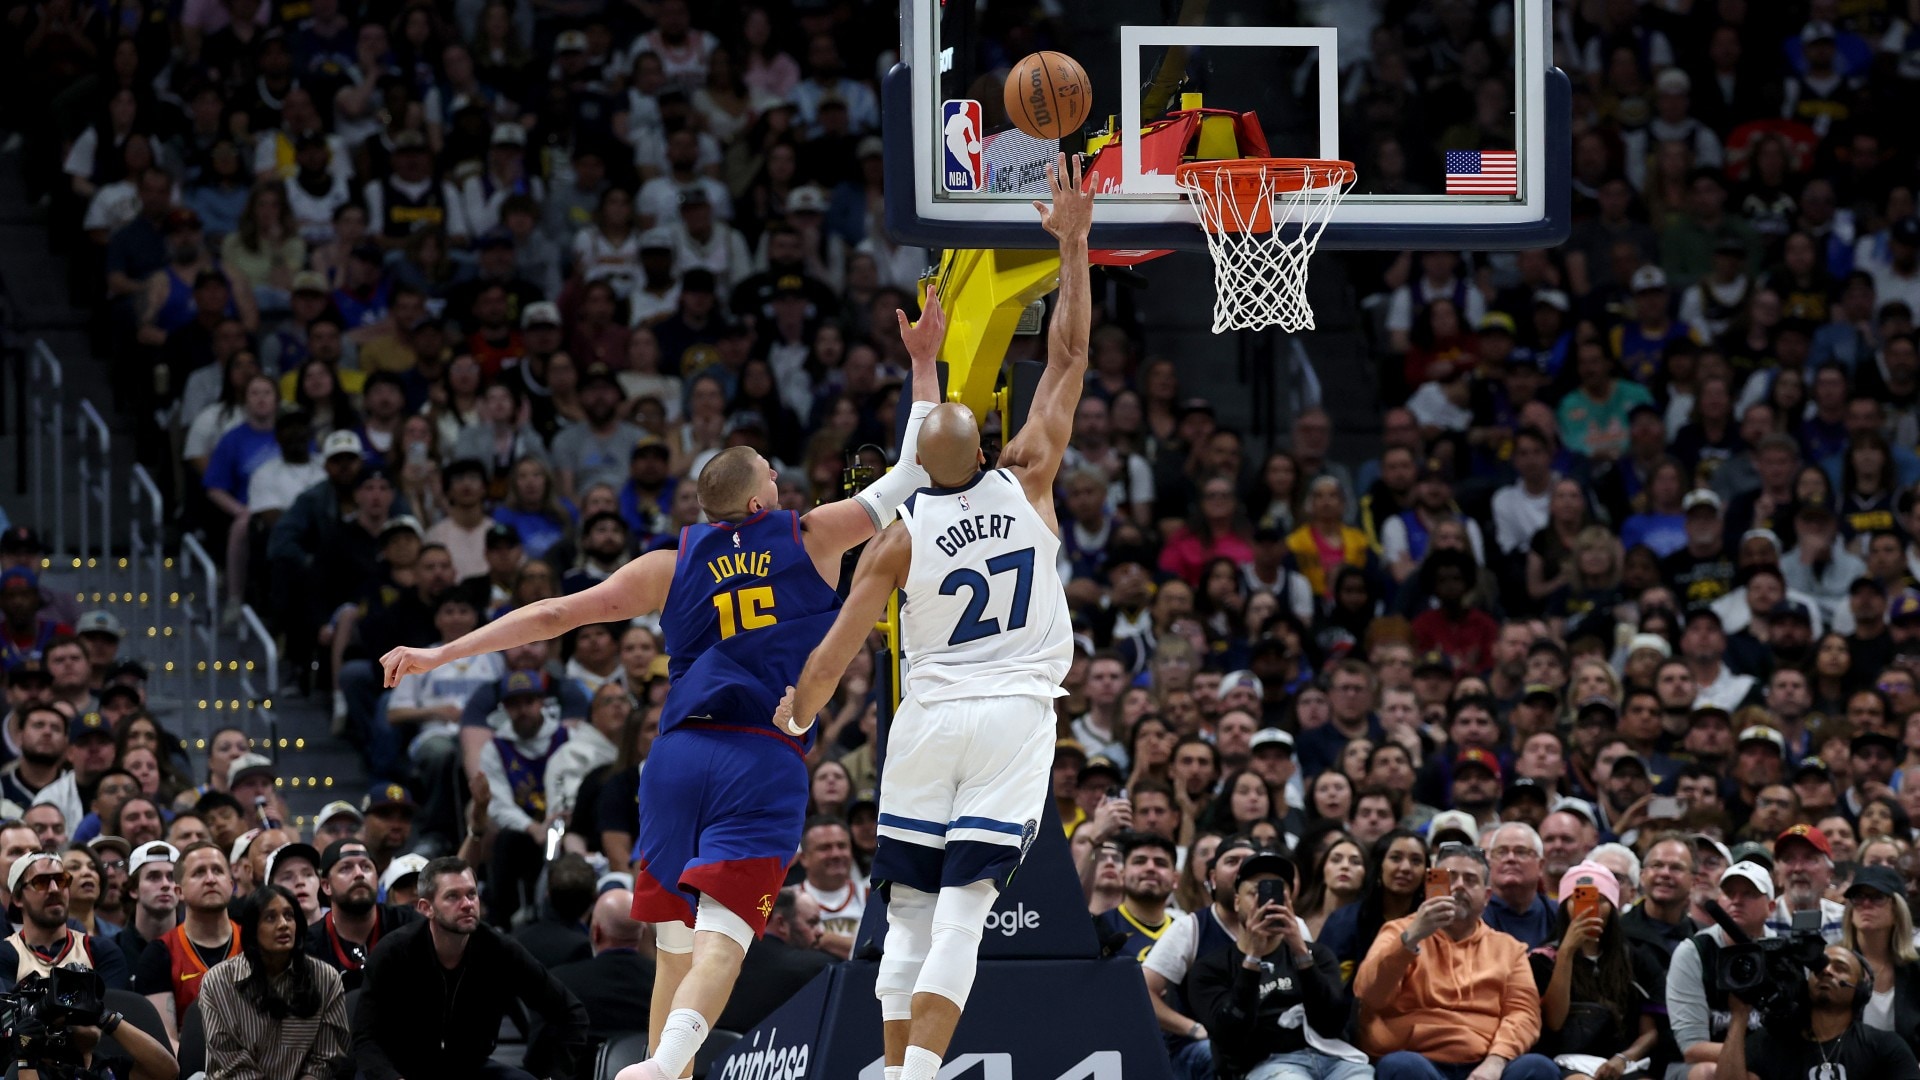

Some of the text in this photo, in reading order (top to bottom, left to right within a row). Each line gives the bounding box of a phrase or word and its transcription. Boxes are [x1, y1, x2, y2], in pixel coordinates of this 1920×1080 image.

[1030, 67, 1051, 127] Wilson
[949, 171, 968, 187] NBA
[995, 164, 1014, 193] NBC
[935, 514, 1016, 557] GOBERT
[707, 550, 772, 584] JOKIĆ
[712, 585, 777, 640] 15
[938, 547, 1035, 646] 27
[984, 902, 1040, 936] ogle
